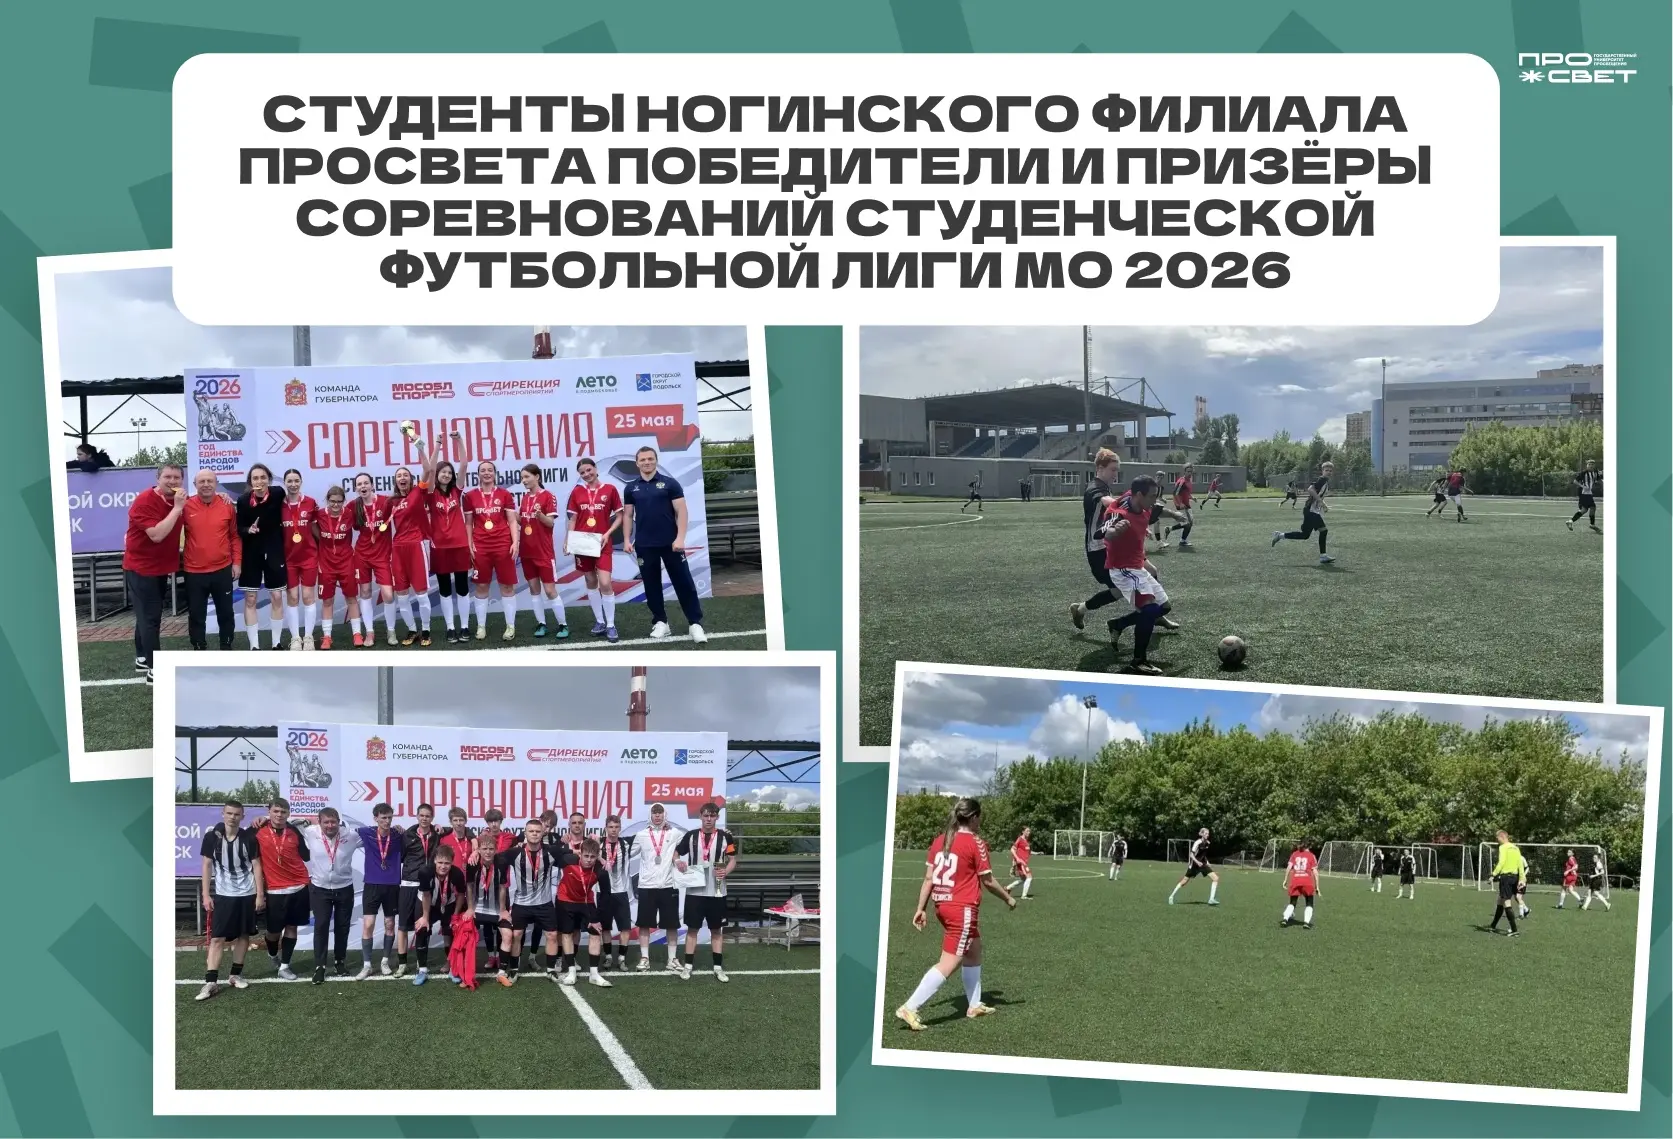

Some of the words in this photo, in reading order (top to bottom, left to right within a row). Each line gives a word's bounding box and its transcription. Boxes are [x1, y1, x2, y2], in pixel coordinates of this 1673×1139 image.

[195, 379, 241, 395] 2026
[314, 384, 361, 393] КОМАНДА
[391, 382, 453, 391] МОСОБЛ
[492, 379, 560, 390] ДИРЕКЦИЯ
[315, 395, 378, 403] ГУБЕРНАТОРА
[392, 391, 440, 400] СПОРТ
[613, 413, 636, 429] 25
[641, 415, 675, 427] мая
[198, 450, 244, 458] ЕДИНСТВА
[199, 457, 240, 465] НАРОДОВ
[98, 491, 140, 508] ОКР
[287, 731, 328, 748] 2026
[392, 743, 433, 752] КОМАНДА
[460, 745, 514, 754] МОСОБЛ
[392, 752, 449, 761] ГУБЕРНАТОРА
[460, 753, 501, 761] СПОРТ
[547, 748, 609, 758] ДИРЕКЦИЯ
[651, 783, 671, 797] 25
[674, 785, 705, 797] мая
[385, 776, 633, 820] СОРЕВНОВАНИЯ
[932, 851, 958, 887] 22
